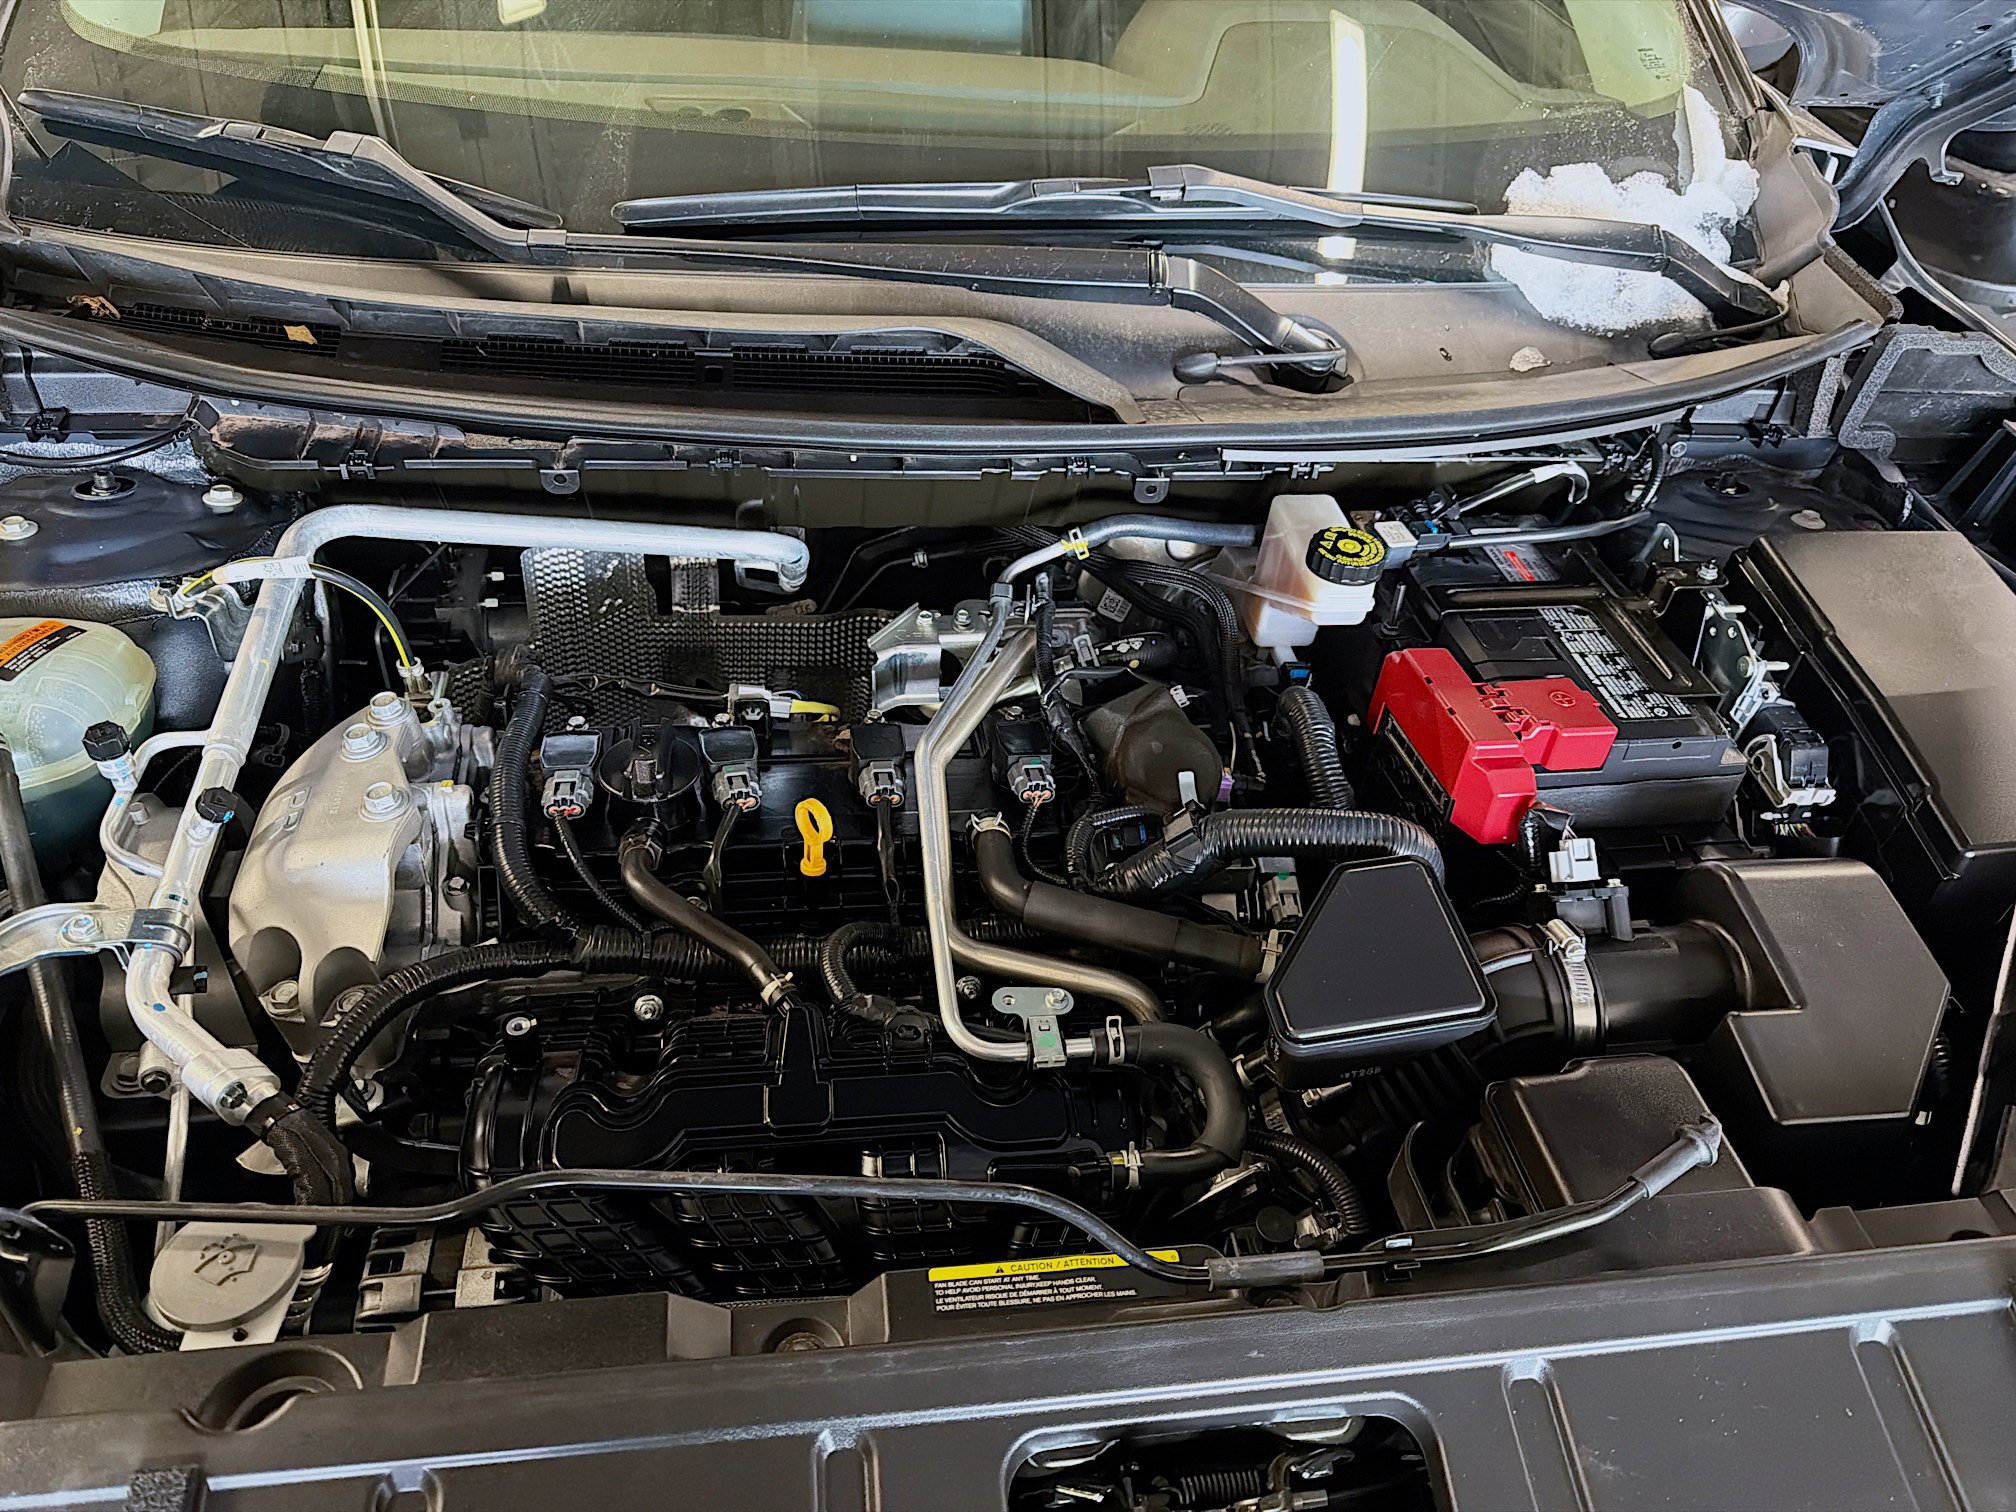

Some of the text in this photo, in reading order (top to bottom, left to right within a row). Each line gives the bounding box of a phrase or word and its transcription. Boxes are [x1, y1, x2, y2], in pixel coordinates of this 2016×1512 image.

[1010, 1262, 1053, 1272] CAUTION
[1063, 1257, 1115, 1268] ATTENTION
[962, 1286, 981, 1294] AVOID
[982, 1284, 1014, 1292] PERSONAL
[1053, 1278, 1074, 1286] HANDS
[944, 1295, 984, 1303] VENTILATEUR
[985, 1292, 1008, 1300] RISQUE
[1019, 1289, 1053, 1297] DÉMARRER
[1059, 1286, 1075, 1294] TOUT
[956, 1301, 977, 1310] ÉVITER
[977, 1300, 998, 1308] TOUTE
[1065, 1291, 1104, 1300] APPROCHER
